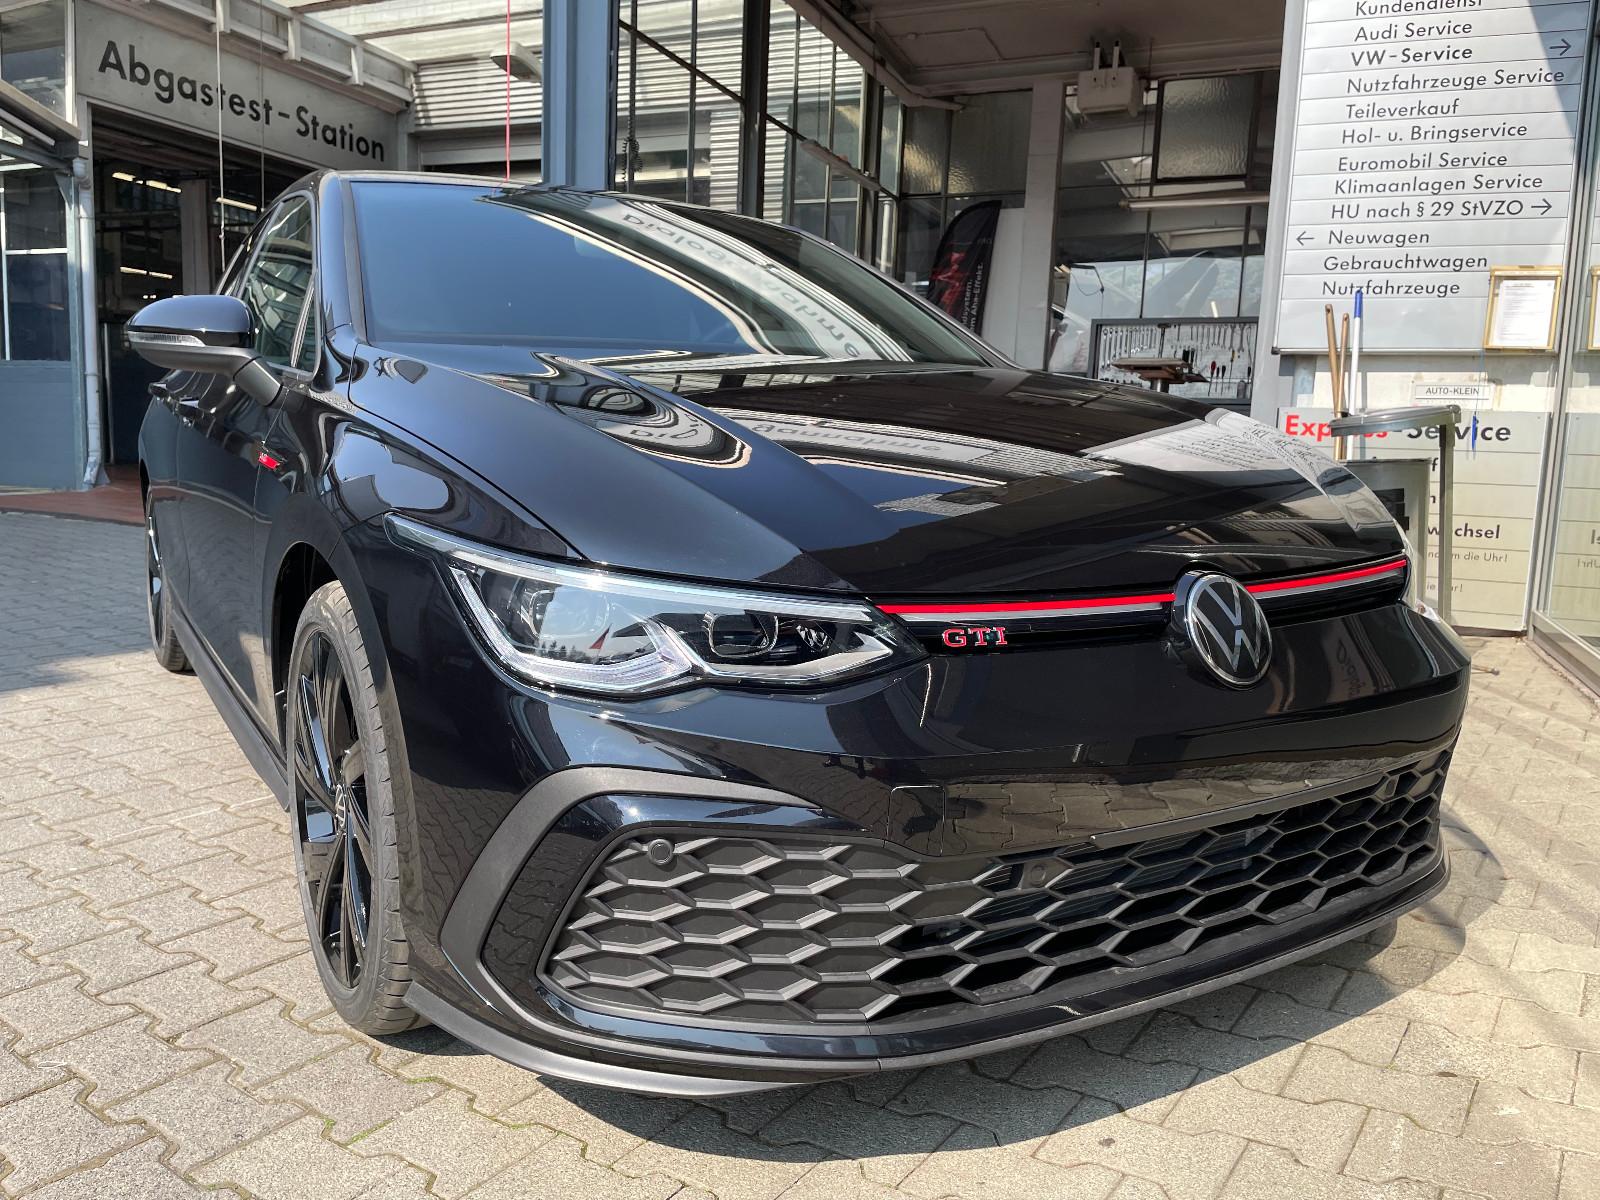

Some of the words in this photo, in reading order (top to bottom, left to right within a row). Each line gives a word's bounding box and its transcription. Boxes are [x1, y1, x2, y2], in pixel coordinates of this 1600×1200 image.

[1354, 25, 1398, 42] Audi
[1404, 20, 1473, 38] Service
[1351, 46, 1473, 67] VW-Service
[1346, 73, 1487, 94] Nutzfahrzeuge
[1493, 68, 1565, 86] Service
[98, 40, 385, 162] Abgastest-Station
[1346, 98, 1460, 120] Teileverkauf
[1342, 128, 1381, 144] Hol-
[1388, 131, 1403, 142] u.
[1410, 122, 1528, 143] Bringservice
[1338, 152, 1432, 172] Euromobil
[1438, 152, 1508, 168] Service
[1335, 177, 1467, 196] Klimaanlagen
[1473, 174, 1543, 191] Service
[1331, 204, 1360, 220] HU
[1366, 200, 1410, 218] nach
[1417, 200, 1425, 219] §
[1431, 201, 1454, 217] 29
[1460, 199, 1524, 217] StVZO
[1328, 230, 1430, 248] Neuwagen
[1324, 254, 1488, 273] Gebrauchtwagen
[1425, 386, 1480, 395] AUTO-KLEIN
[942, 626, 1008, 648] GTI
